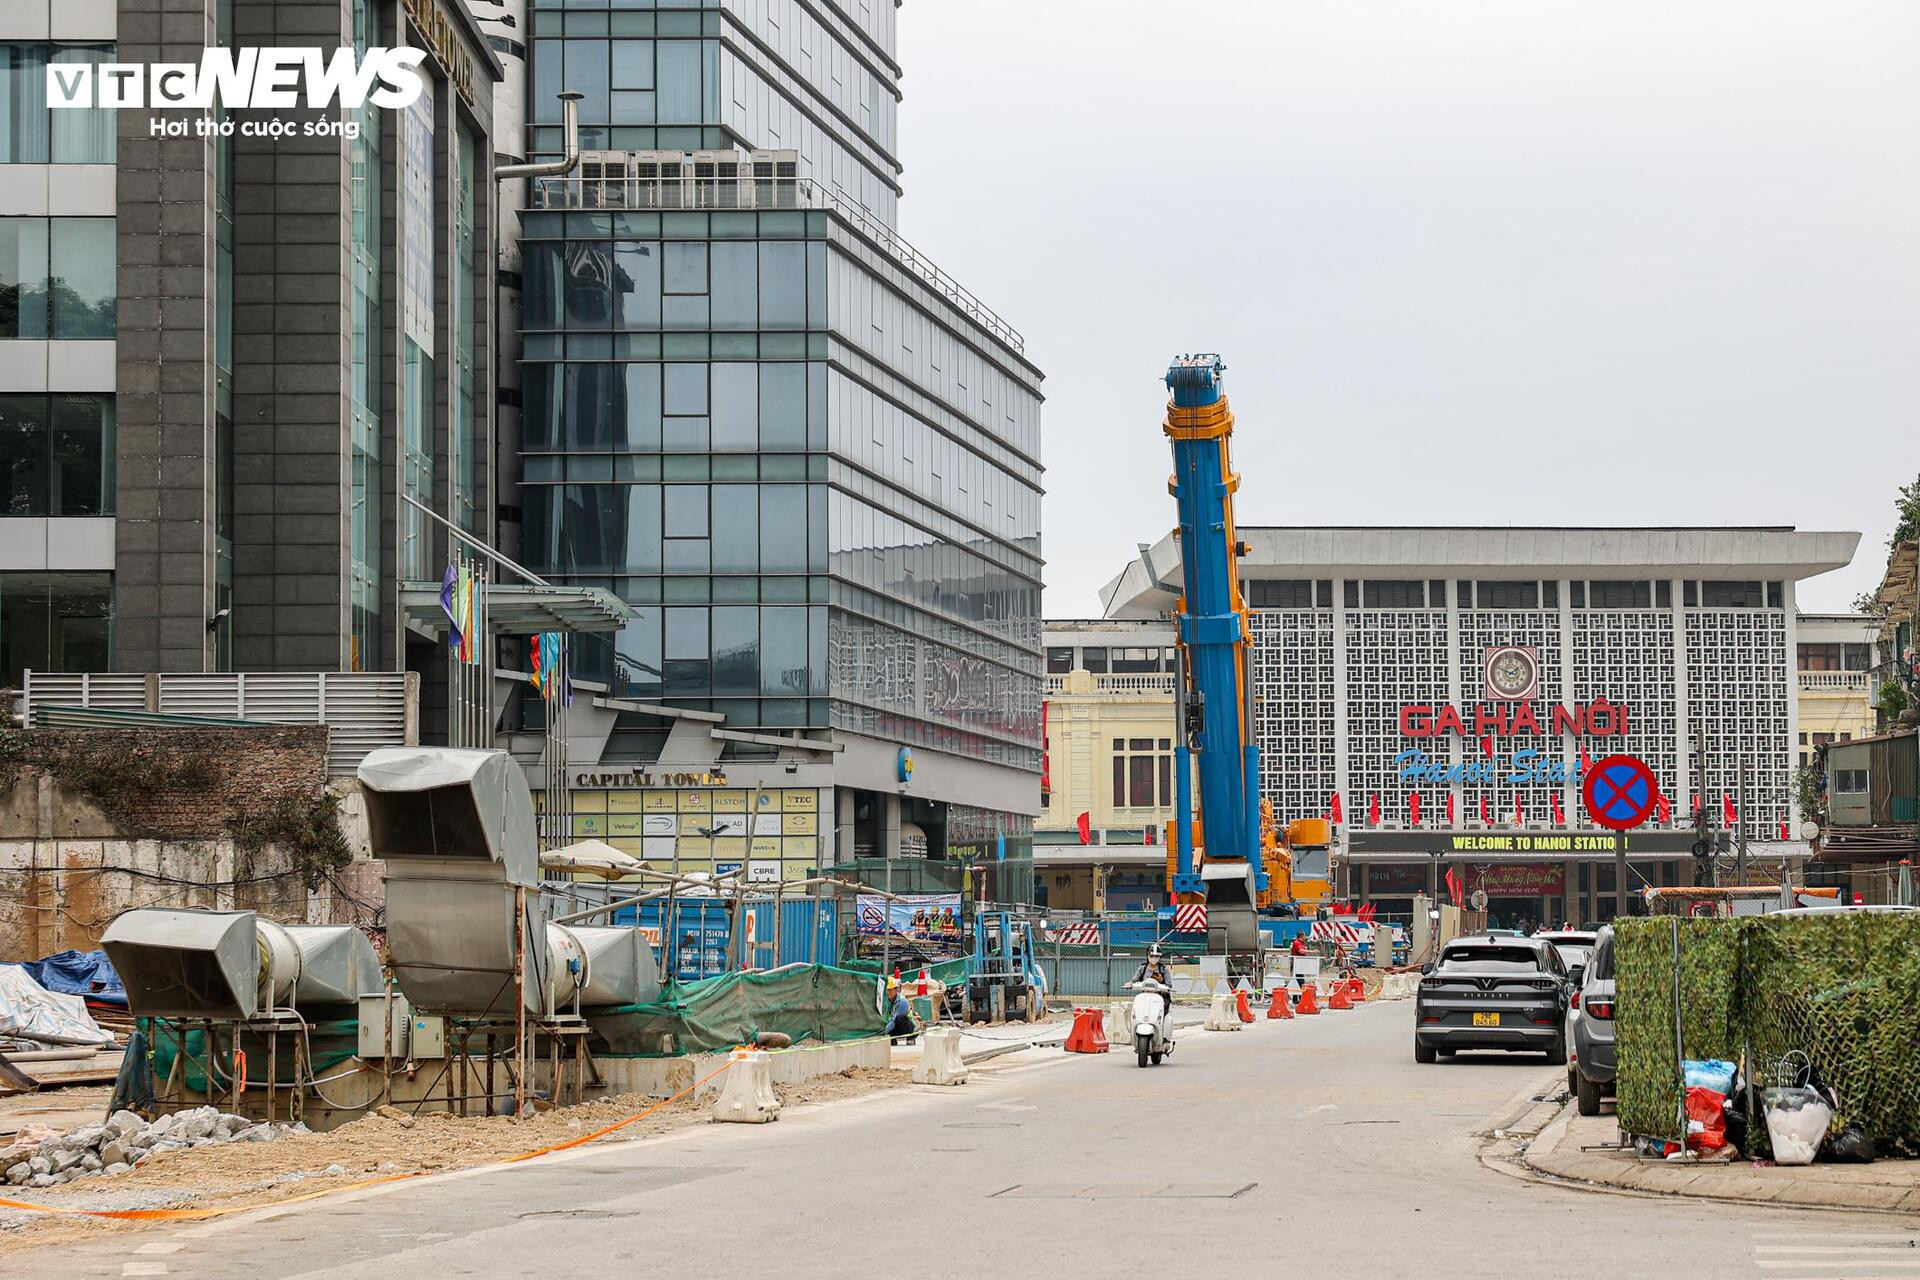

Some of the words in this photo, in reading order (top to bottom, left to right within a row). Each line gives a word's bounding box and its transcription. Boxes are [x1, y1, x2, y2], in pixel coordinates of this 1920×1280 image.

[1399, 705, 1466, 737] GA
[1394, 748, 1498, 784] Hanoi
[576, 773, 655, 787] CAPITAL
[1452, 836, 1514, 850] WELCOME
[1516, 836, 1531, 850] TO
[1533, 836, 1571, 850] HANOI
